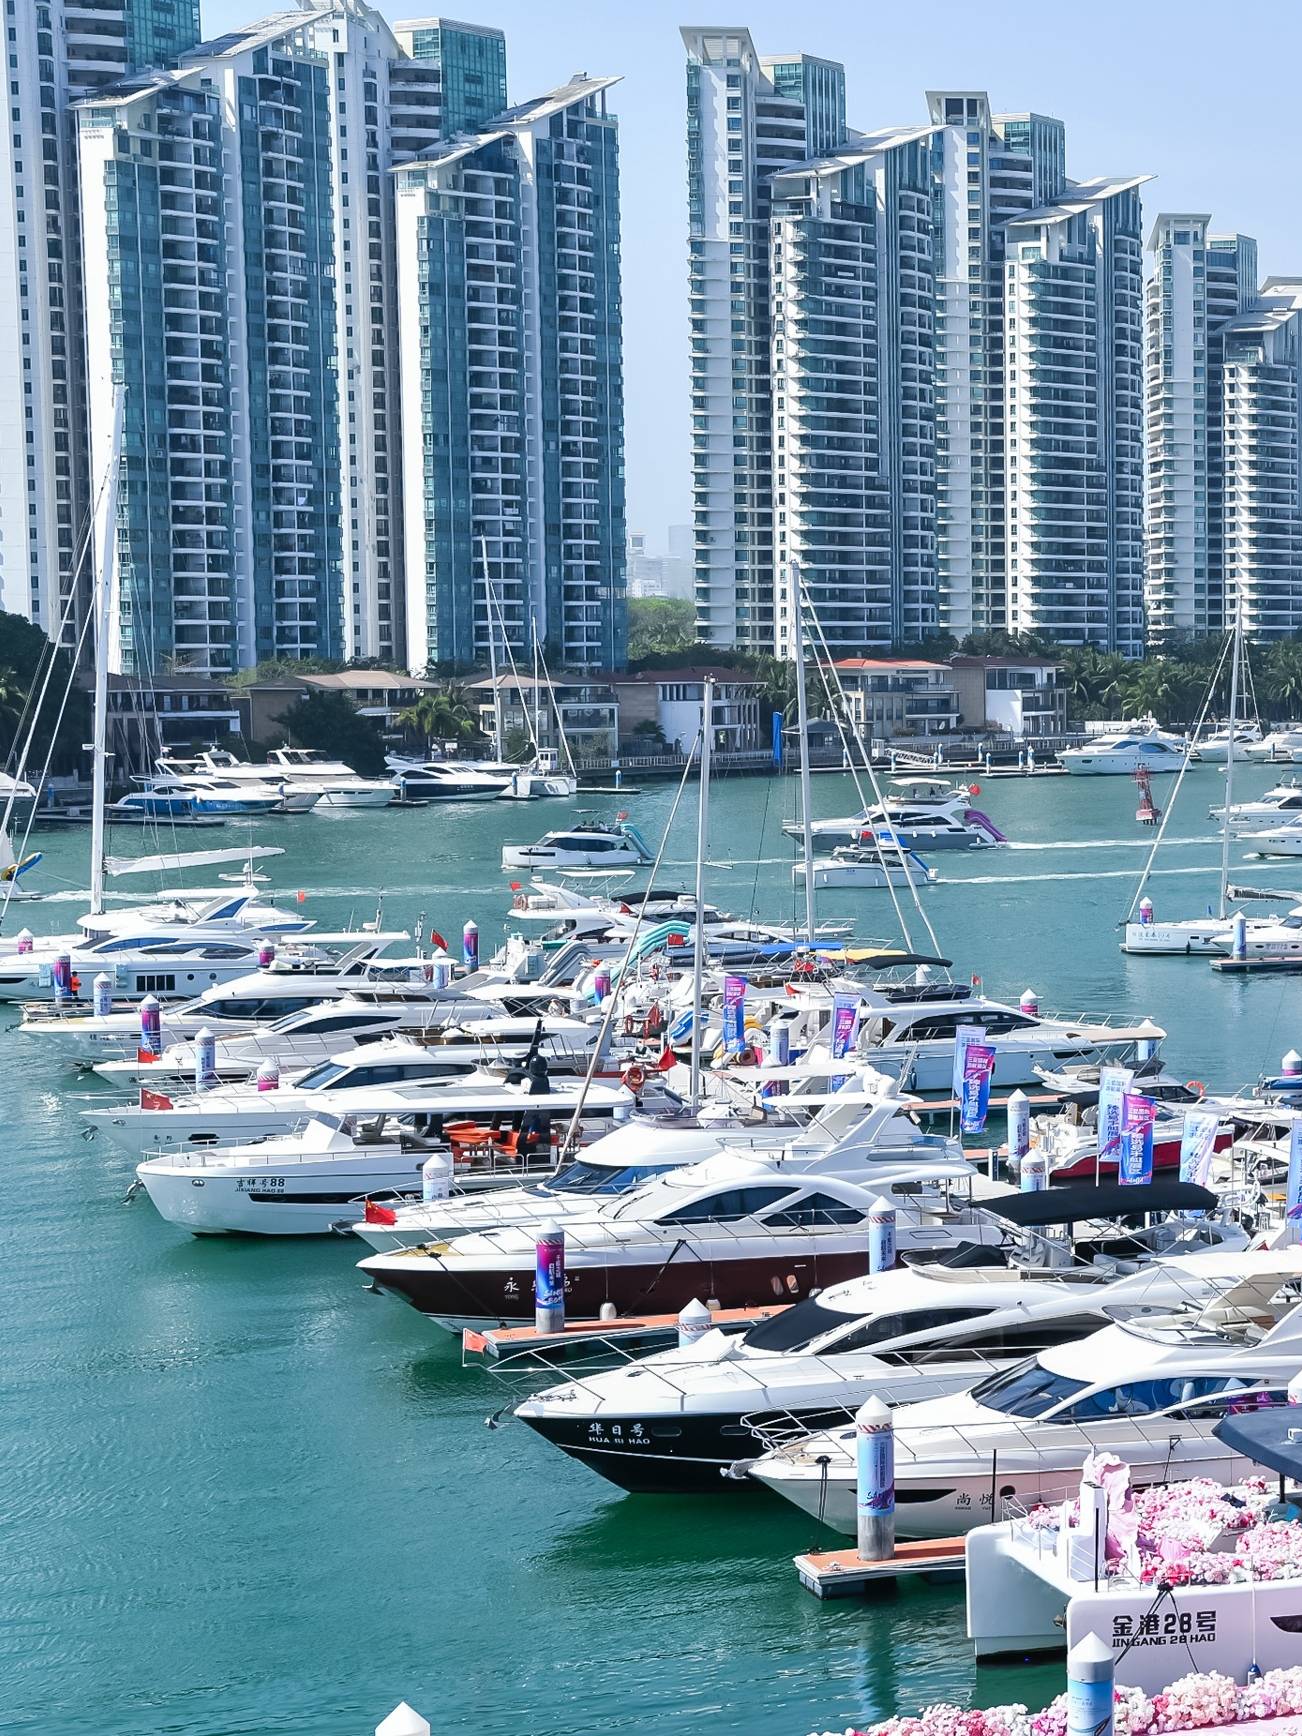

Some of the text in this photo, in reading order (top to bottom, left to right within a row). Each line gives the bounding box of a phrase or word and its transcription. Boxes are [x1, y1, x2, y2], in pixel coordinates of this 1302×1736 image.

[1112, 1610, 1216, 1637] 金港28号
[1112, 1633, 1216, 1648] JINGANG 28 HAO
